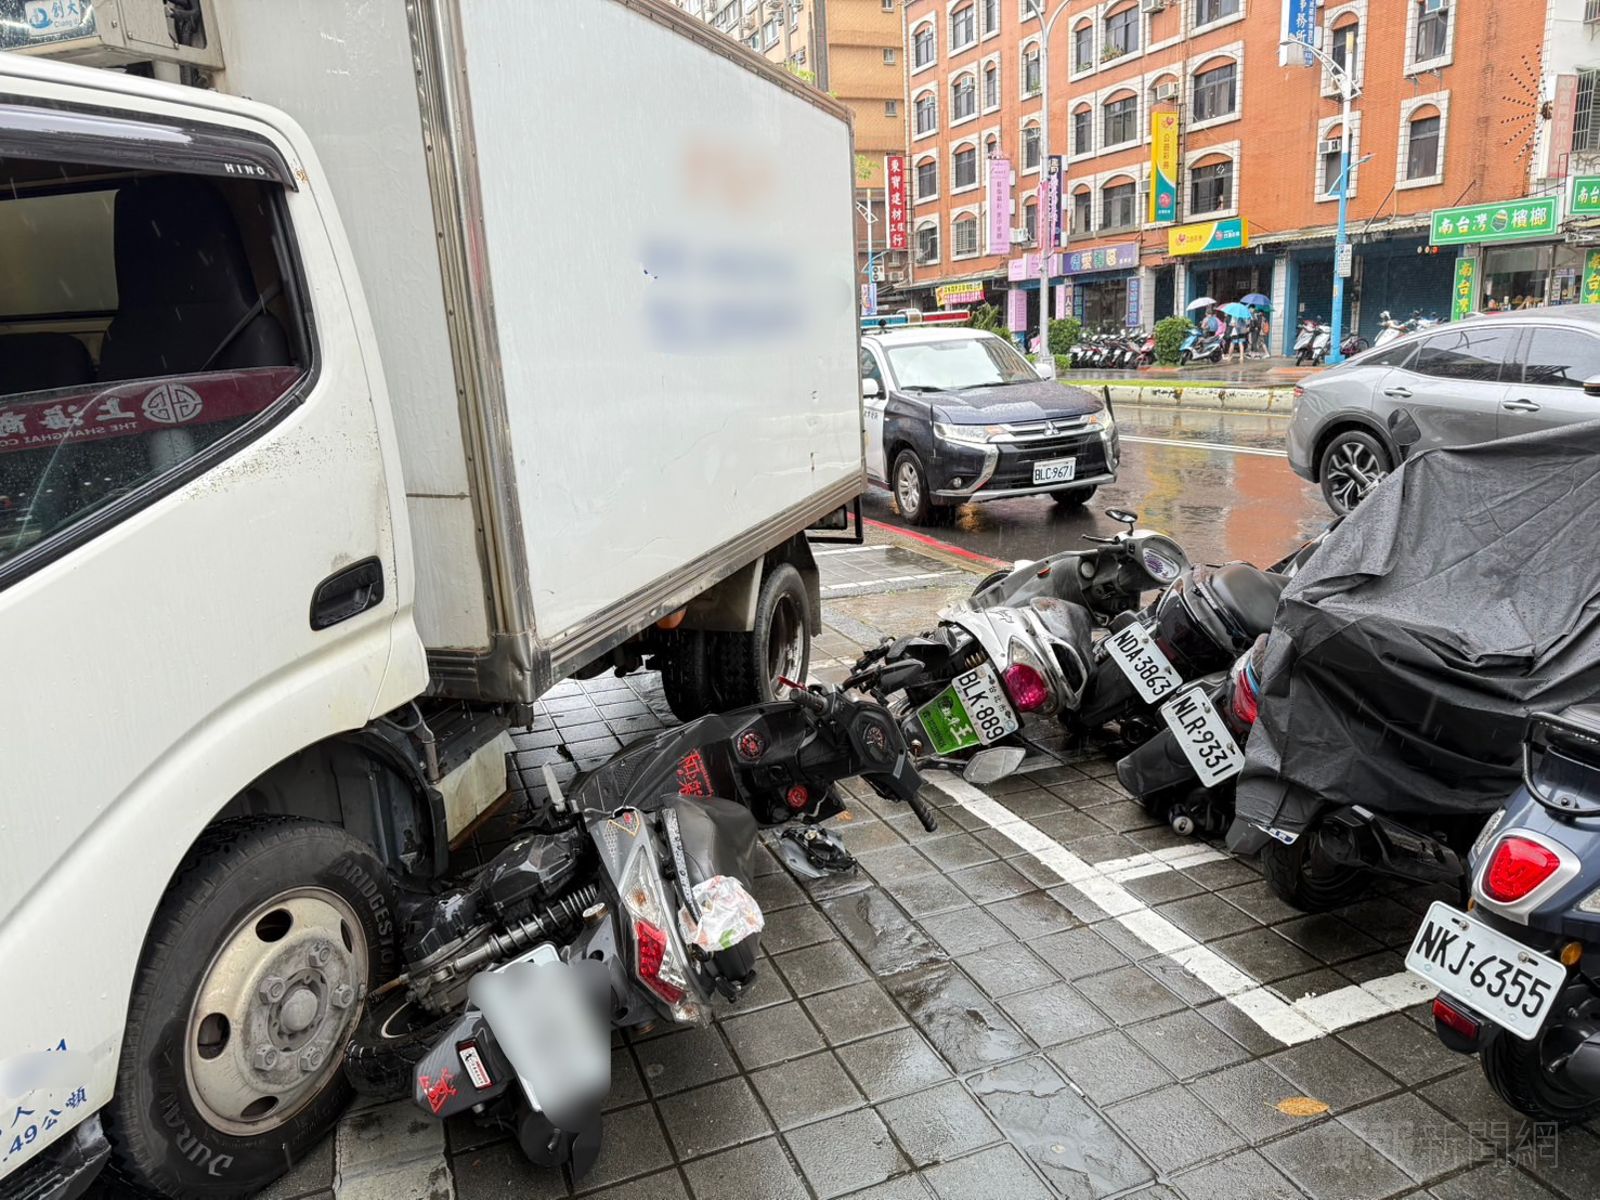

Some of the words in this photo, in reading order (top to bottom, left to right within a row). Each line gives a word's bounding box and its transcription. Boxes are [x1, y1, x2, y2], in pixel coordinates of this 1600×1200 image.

[224, 163, 266, 175] HINO
[1438, 212, 1488, 235] 南台灣
[1511, 207, 1548, 228] 檳榔
